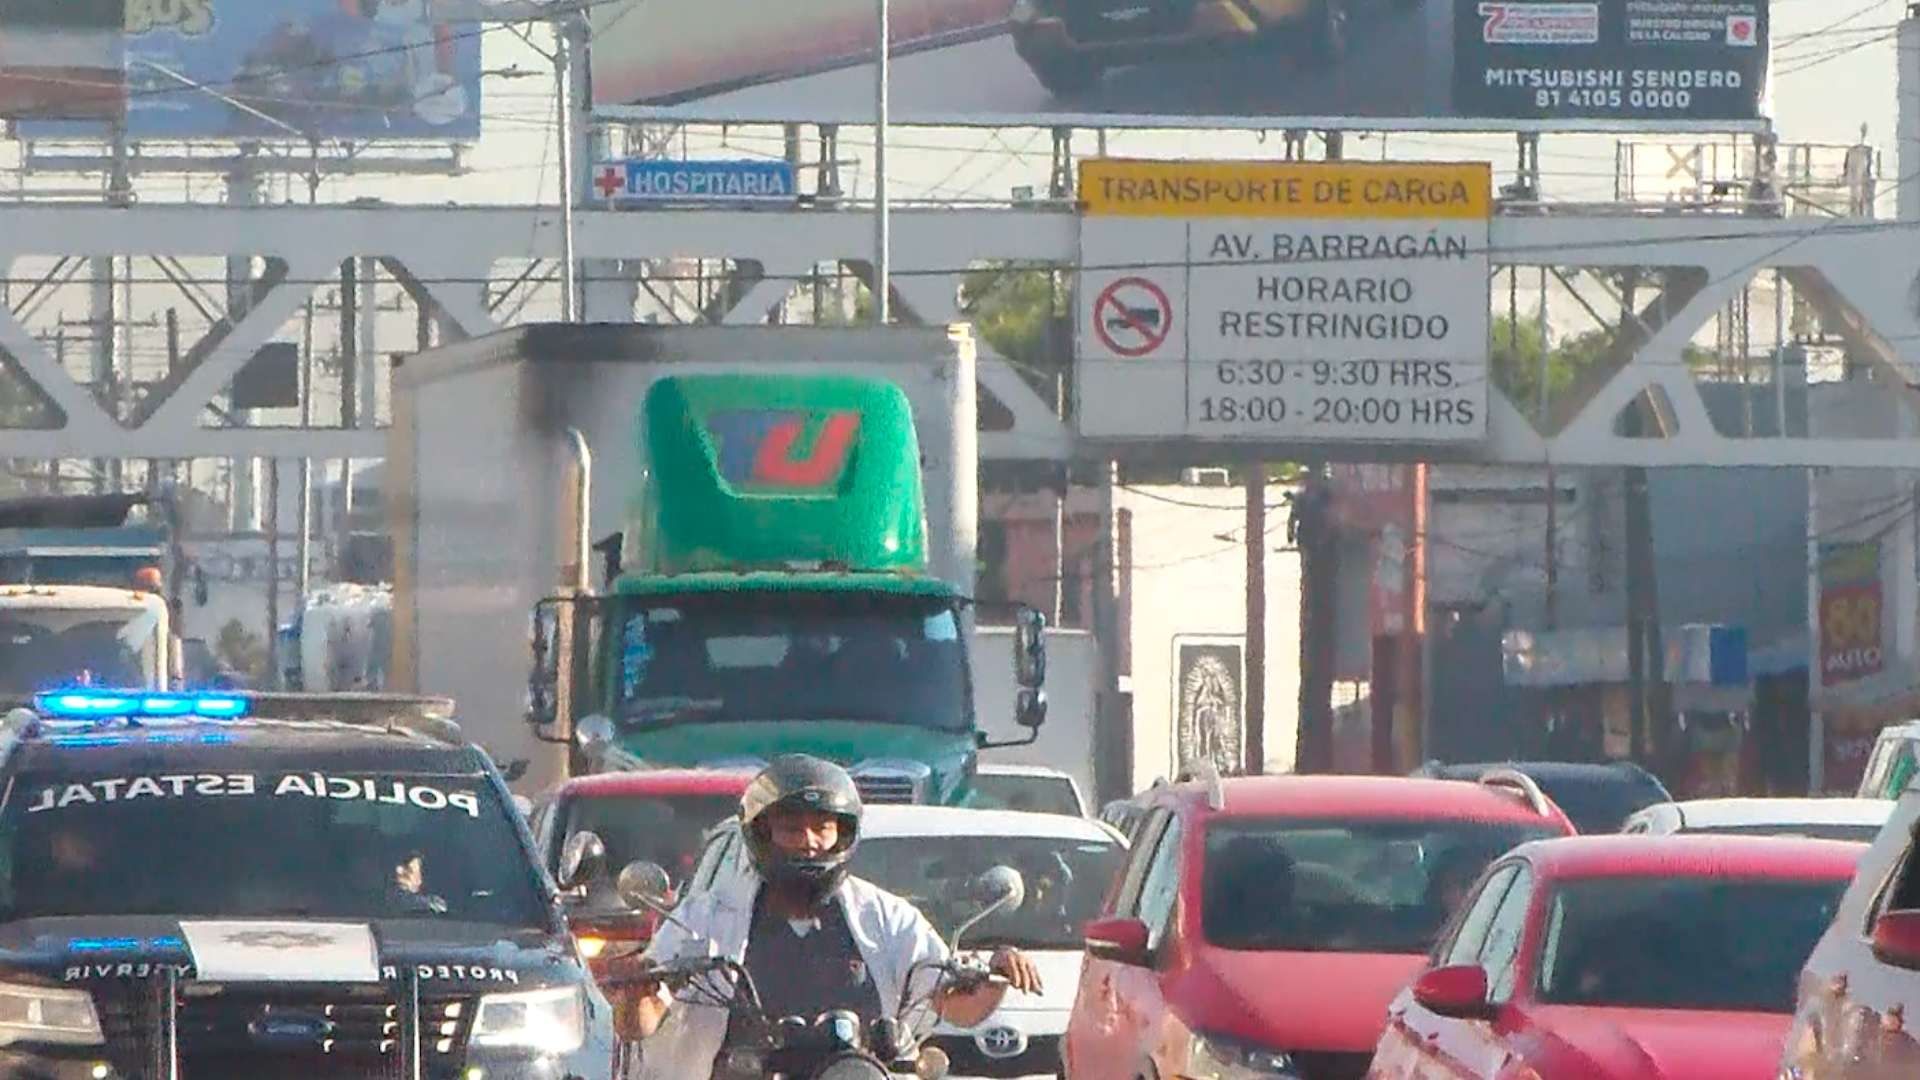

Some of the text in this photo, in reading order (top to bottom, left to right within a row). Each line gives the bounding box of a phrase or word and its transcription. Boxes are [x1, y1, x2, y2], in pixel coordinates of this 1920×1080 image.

[1485, 69, 1742, 88] MITSUBISHI SENDERO
[1535, 89, 1690, 108] 81 4105 0000
[633, 171, 786, 195] HOSPITARIA
[1098, 177, 1470, 206] TRANSPORTE DE CARGA
[1209, 229, 1468, 261] AV. BARRAGÁN
[1258, 277, 1413, 303] HORARIO
[1219, 311, 1449, 340] RESTRINGIDO
[1217, 359, 1285, 386] 6:30
[1312, 360, 1379, 386] 9:30
[1200, 396, 1286, 423] 18:00
[1313, 398, 1401, 424] 20:00
[1411, 399, 1474, 425] HRS
